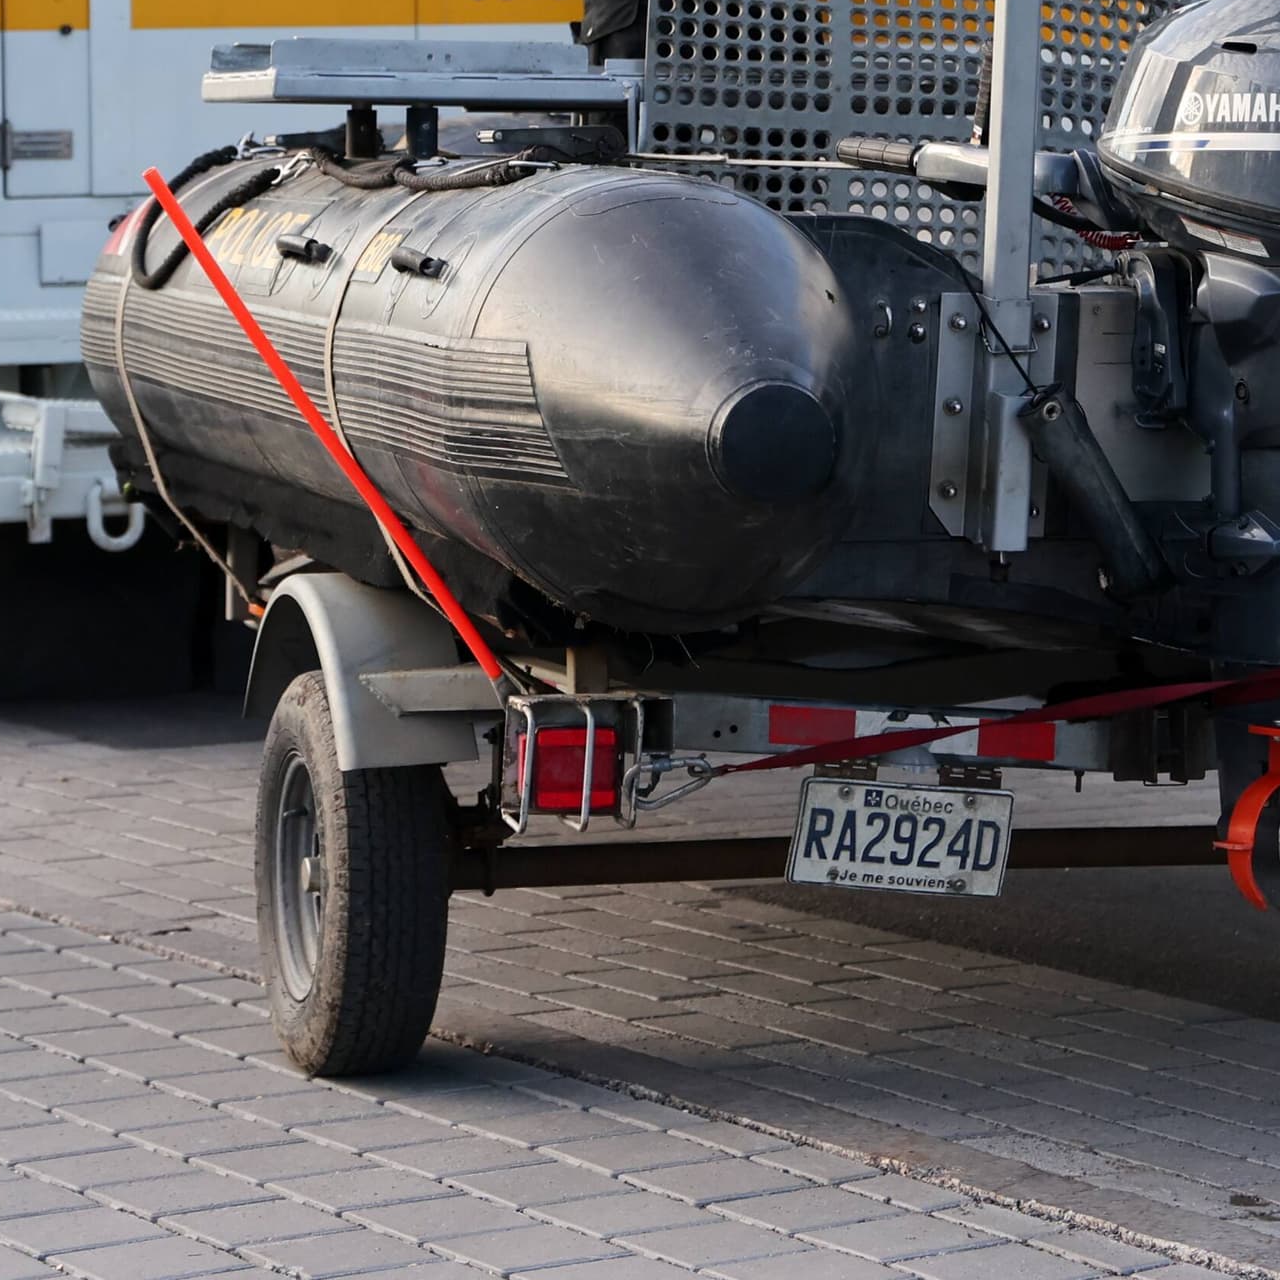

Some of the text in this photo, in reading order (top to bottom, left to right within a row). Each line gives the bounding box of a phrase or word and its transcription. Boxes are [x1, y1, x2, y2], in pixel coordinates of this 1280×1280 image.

[884, 793, 955, 815] Québec
[802, 807, 1002, 872] RA2924D
[838, 869, 954, 890] Je me souviens
